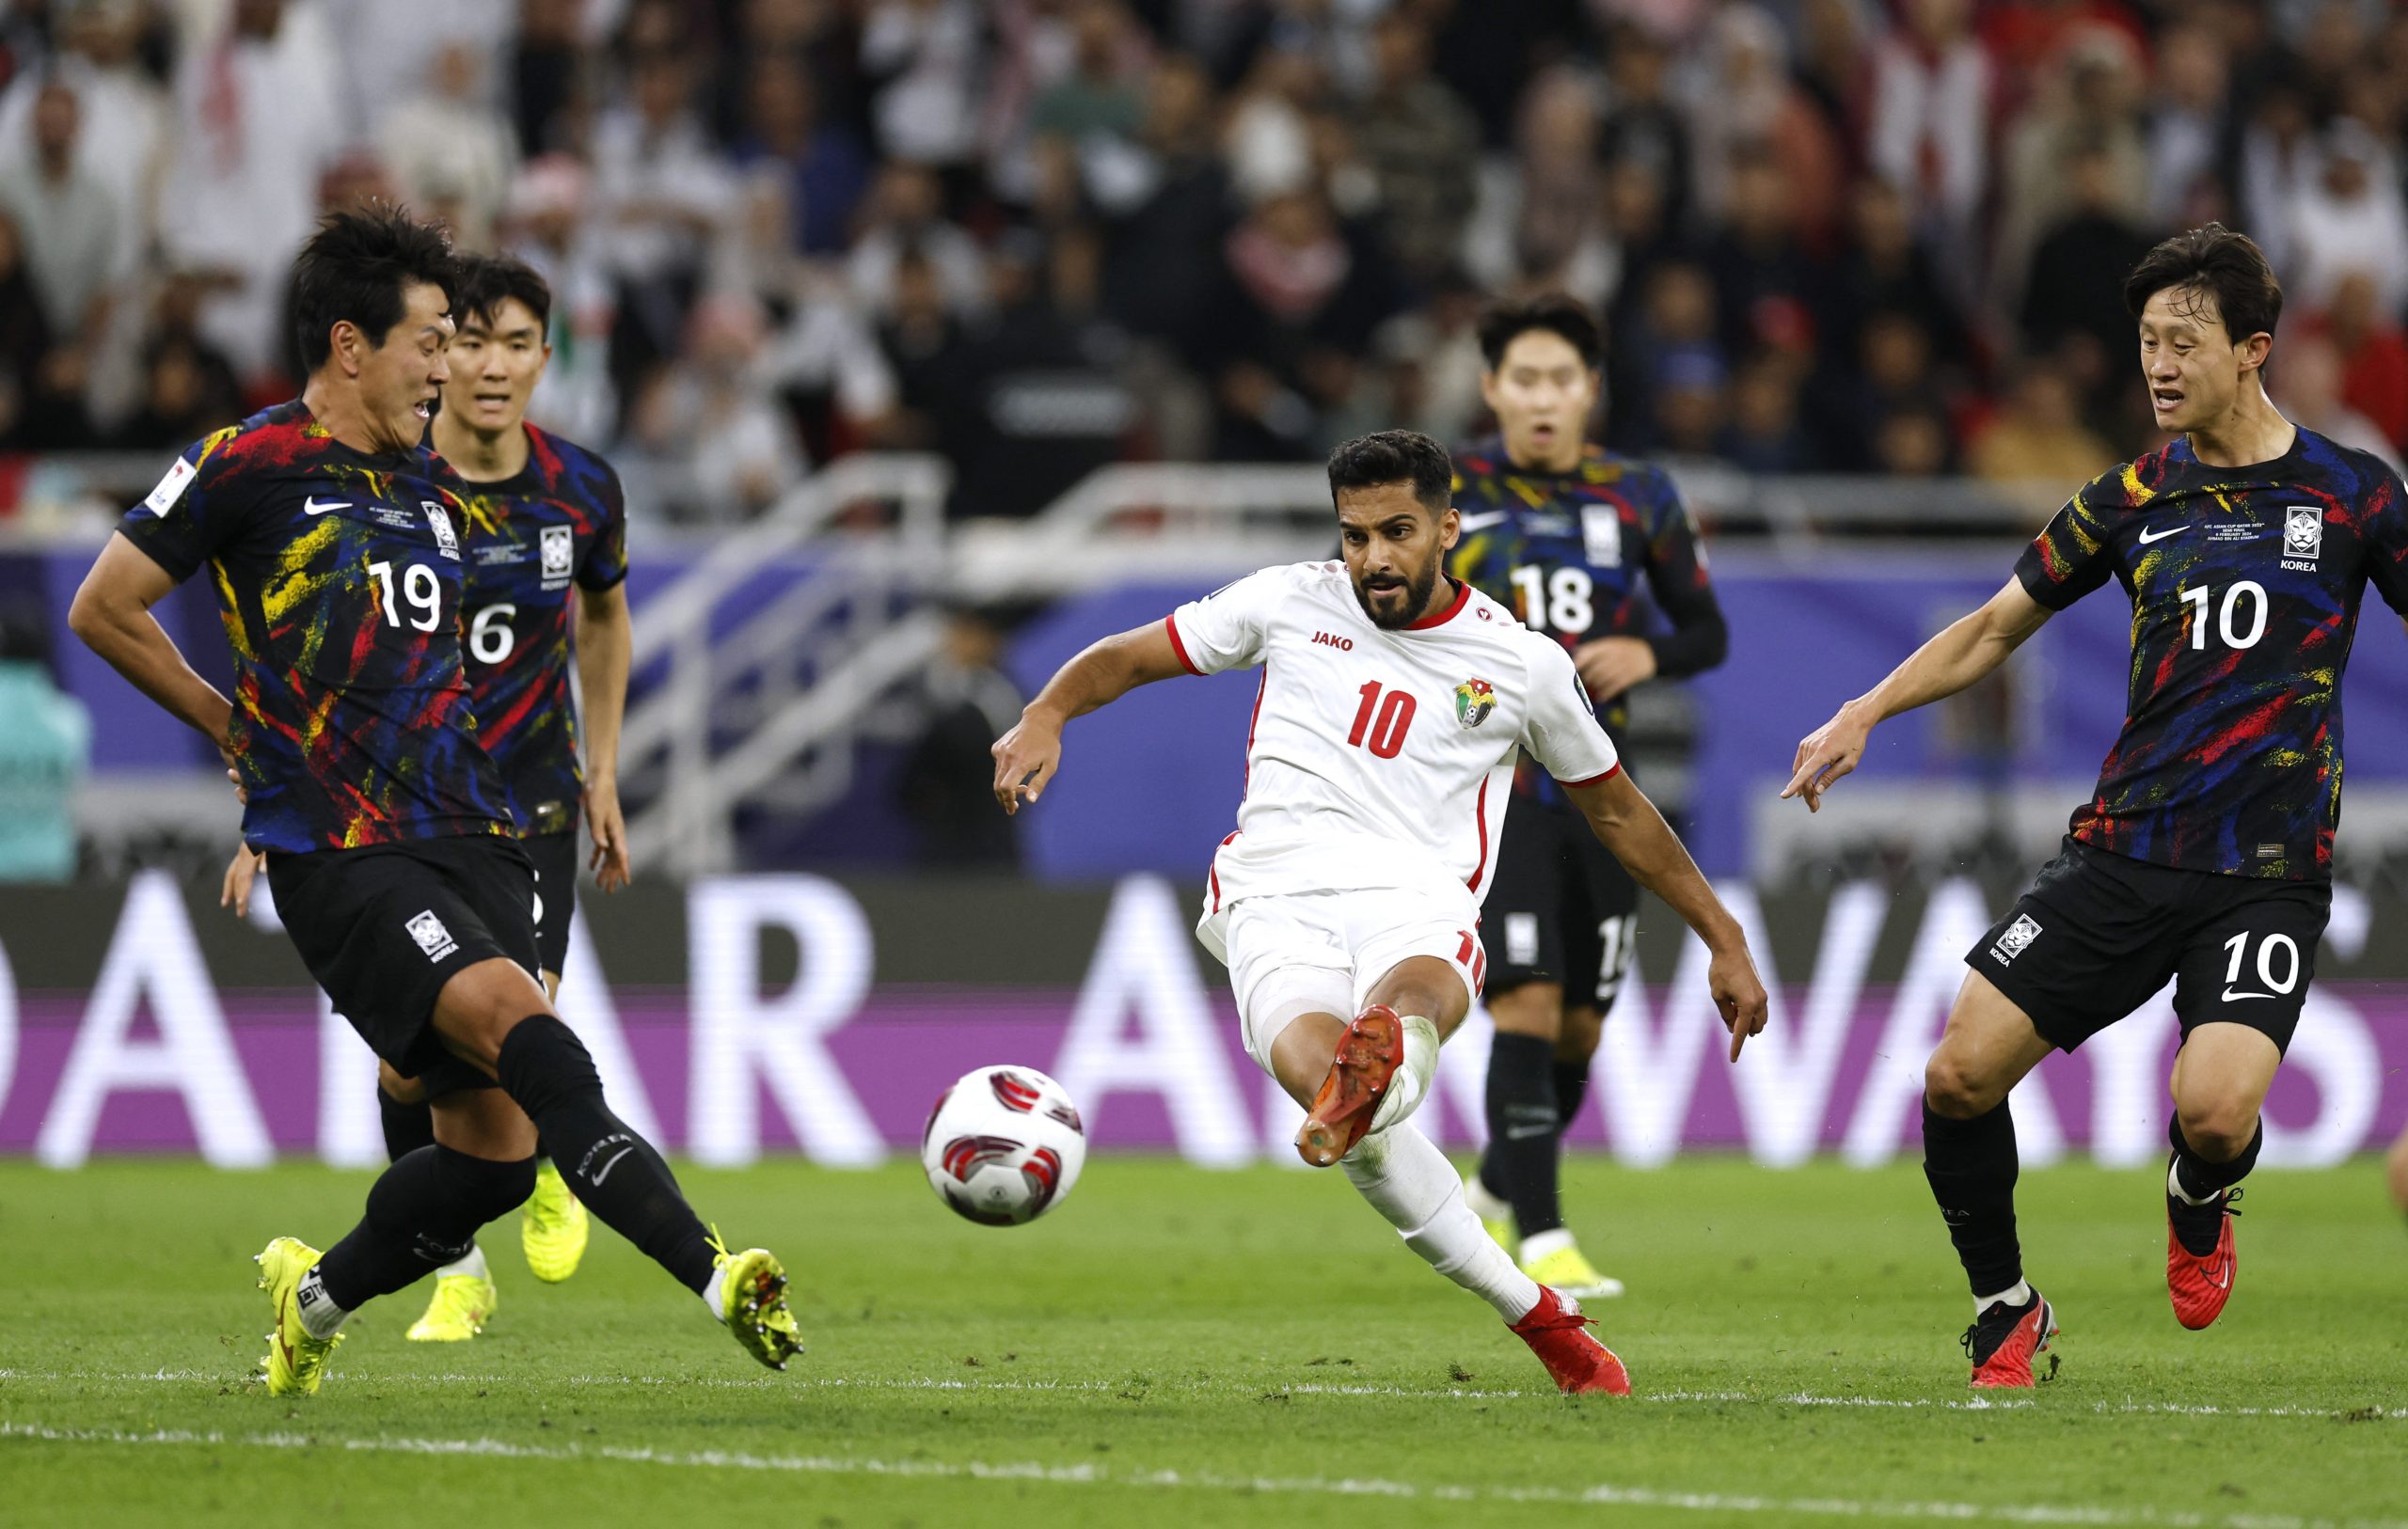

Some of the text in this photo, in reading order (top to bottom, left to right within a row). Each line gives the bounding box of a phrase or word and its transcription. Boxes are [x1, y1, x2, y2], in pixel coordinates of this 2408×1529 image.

[369, 561, 441, 632] 19
[2280, 560, 2317, 572] KOREA
[1510, 564, 1593, 633] 18
[2181, 580, 2268, 650] 10
[470, 604, 516, 665] 6
[1311, 631, 1354, 652] JAKO
[1347, 680, 1418, 759] 10
[430, 942, 459, 964] KOREA
[1989, 947, 2010, 968] KOREA
[2224, 931, 2299, 994] 10
[577, 1134, 632, 1177] KOREA
